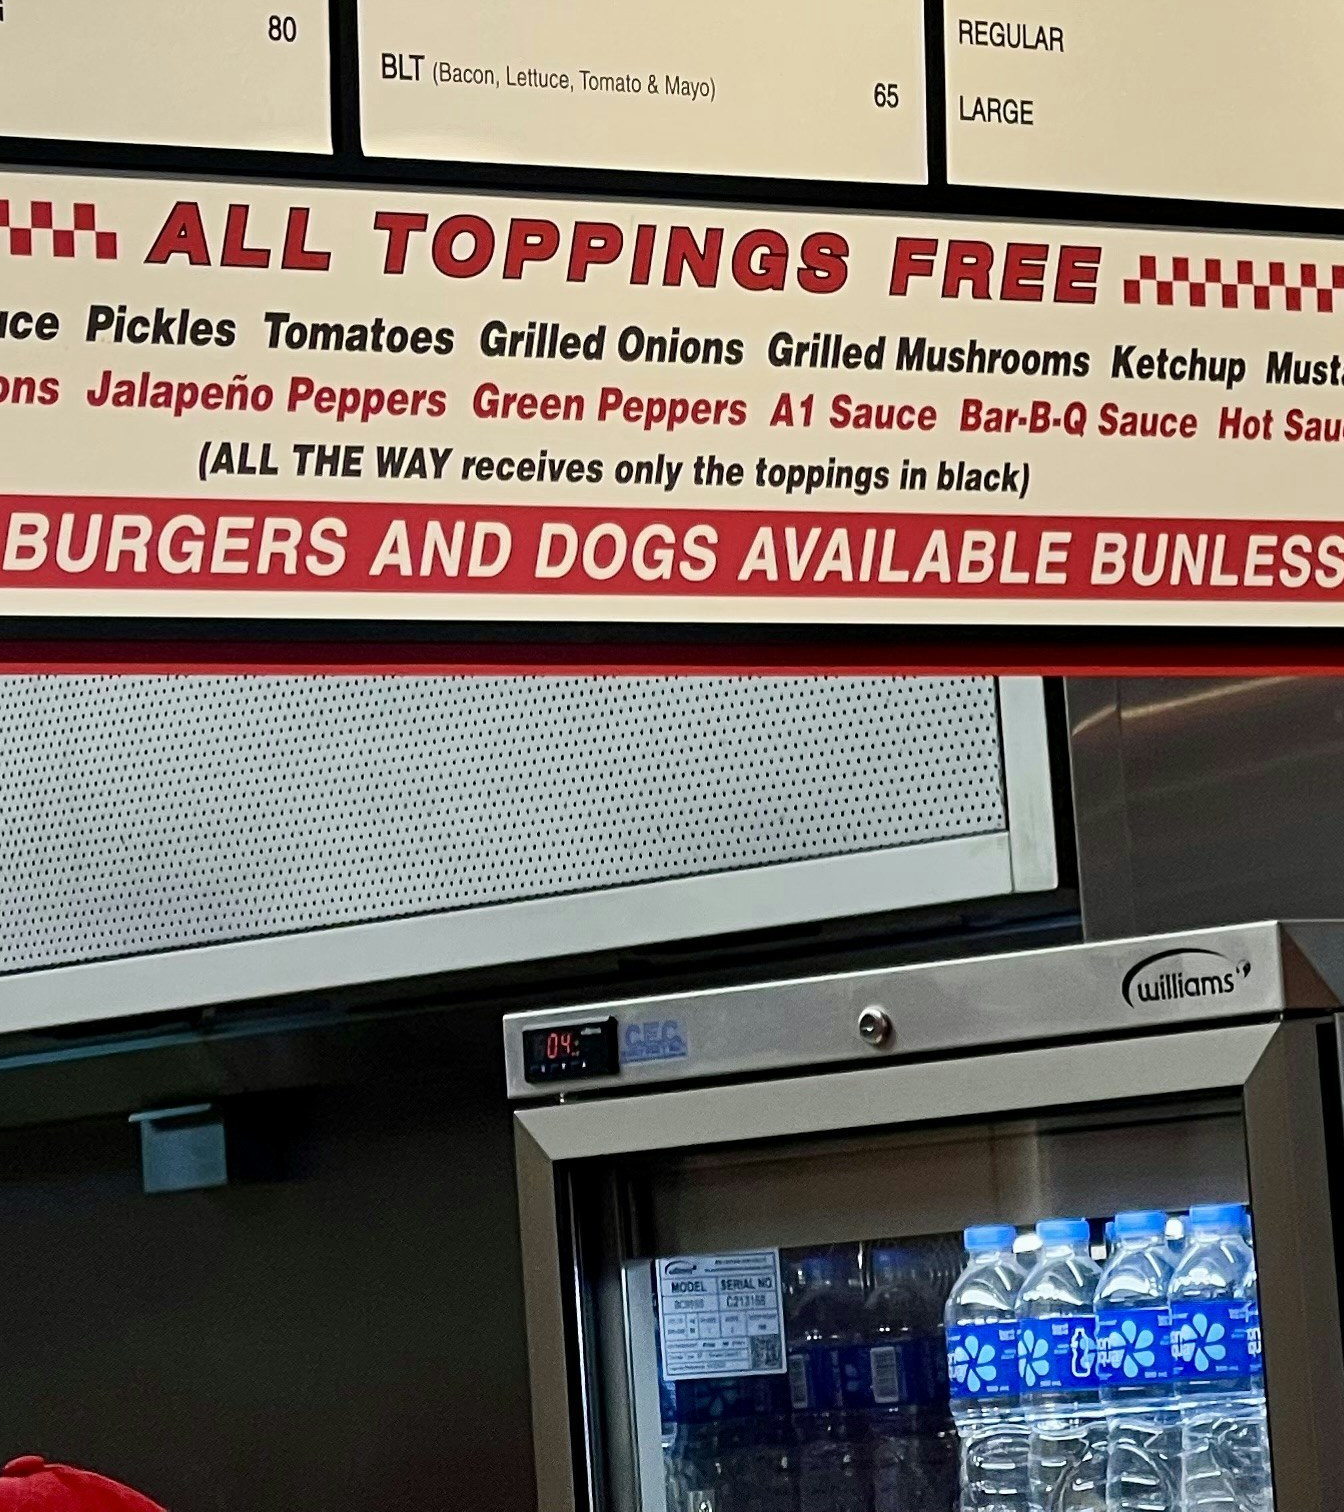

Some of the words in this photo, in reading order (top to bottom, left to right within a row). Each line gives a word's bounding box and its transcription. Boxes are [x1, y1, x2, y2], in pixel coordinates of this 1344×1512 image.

[959, 19, 1064, 52] REGULAR
[382, 53, 425, 81] BLT
[433, 62, 499, 88] (Bacon,
[507, 66, 573, 92] Lettuce,
[579, 71, 641, 92] Tomato
[648, 75, 659, 94] &
[666, 75, 715, 102] Mayo)
[874, 83, 898, 108] 65
[960, 96, 1033, 125] LARGE
[144, 201, 331, 271] ALL
[374, 211, 849, 294] TOPPINGS
[889, 237, 1102, 304] FREE
[86, 305, 235, 346] Pickles
[264, 312, 454, 355] Tomatoes
[480, 320, 606, 360] Grilled
[618, 326, 743, 365] Onions
[768, 332, 886, 370] Grilled
[896, 337, 1089, 377] Mushrooms
[1112, 345, 1245, 390] Ketchup
[87, 370, 273, 417] Jalapeño
[288, 377, 446, 422] Peppers
[473, 382, 584, 420] Green
[598, 387, 746, 431] Peppers
[770, 393, 813, 427] A1
[830, 394, 936, 430] Sauce
[960, 399, 1086, 437] Bar-B-Q
[1098, 403, 1197, 438] Sauce
[1219, 407, 1273, 440] Hot
[199, 442, 278, 481] (ALL
[293, 444, 364, 477] THE
[377, 446, 453, 479] WAY
[462, 450, 603, 483] receives
[615, 454, 683, 491] only
[694, 455, 743, 486] the
[756, 457, 889, 495] toppings
[900, 459, 926, 490] in
[937, 461, 1029, 499] black)
[1137, 972, 1234, 1002] williams
[671, 1280, 707, 1294] MODEL
